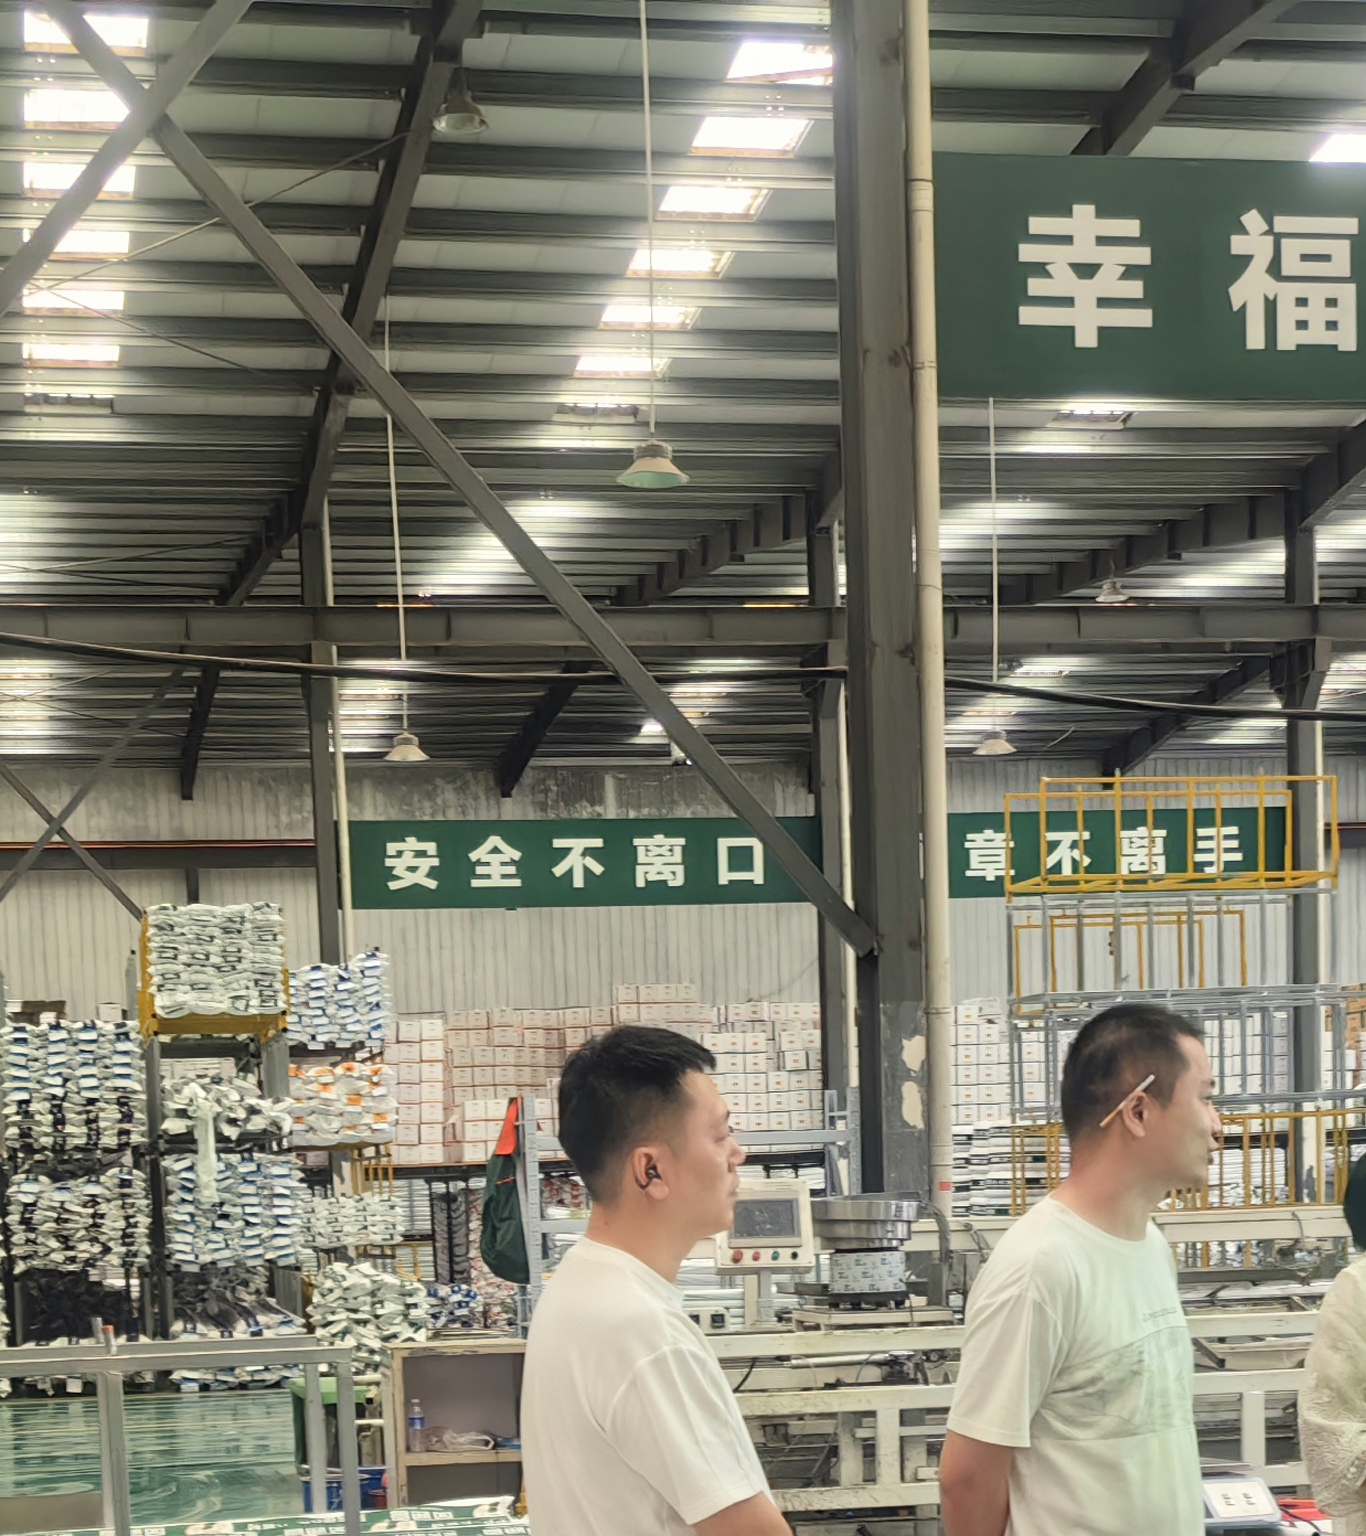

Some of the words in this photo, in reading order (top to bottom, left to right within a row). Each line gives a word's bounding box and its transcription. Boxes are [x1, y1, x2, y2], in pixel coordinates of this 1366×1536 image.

[384, 833, 765, 892] 安全不离口
